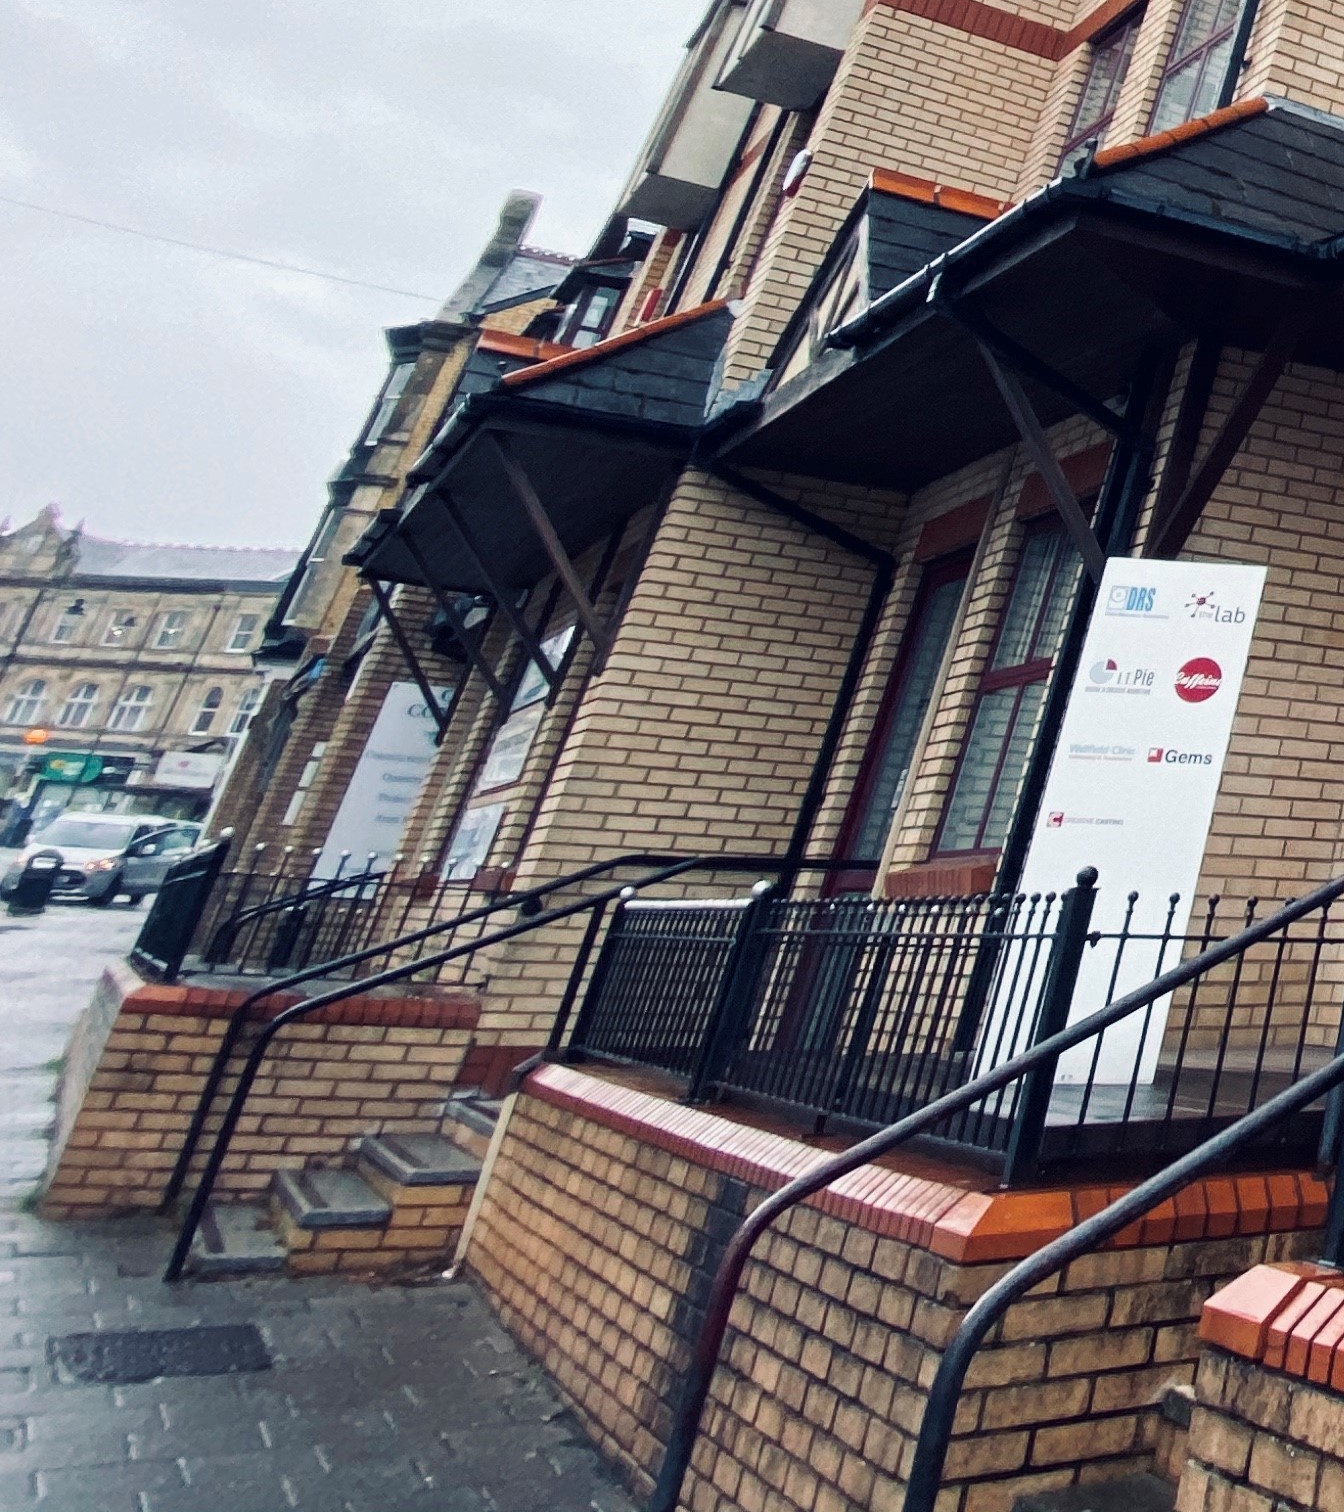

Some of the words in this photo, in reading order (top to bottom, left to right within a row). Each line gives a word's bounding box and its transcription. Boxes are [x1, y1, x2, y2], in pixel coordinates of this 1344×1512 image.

[1126, 586, 1156, 611] DRS
[1215, 605, 1246, 624] lab
[1165, 749, 1213, 765] Gems
